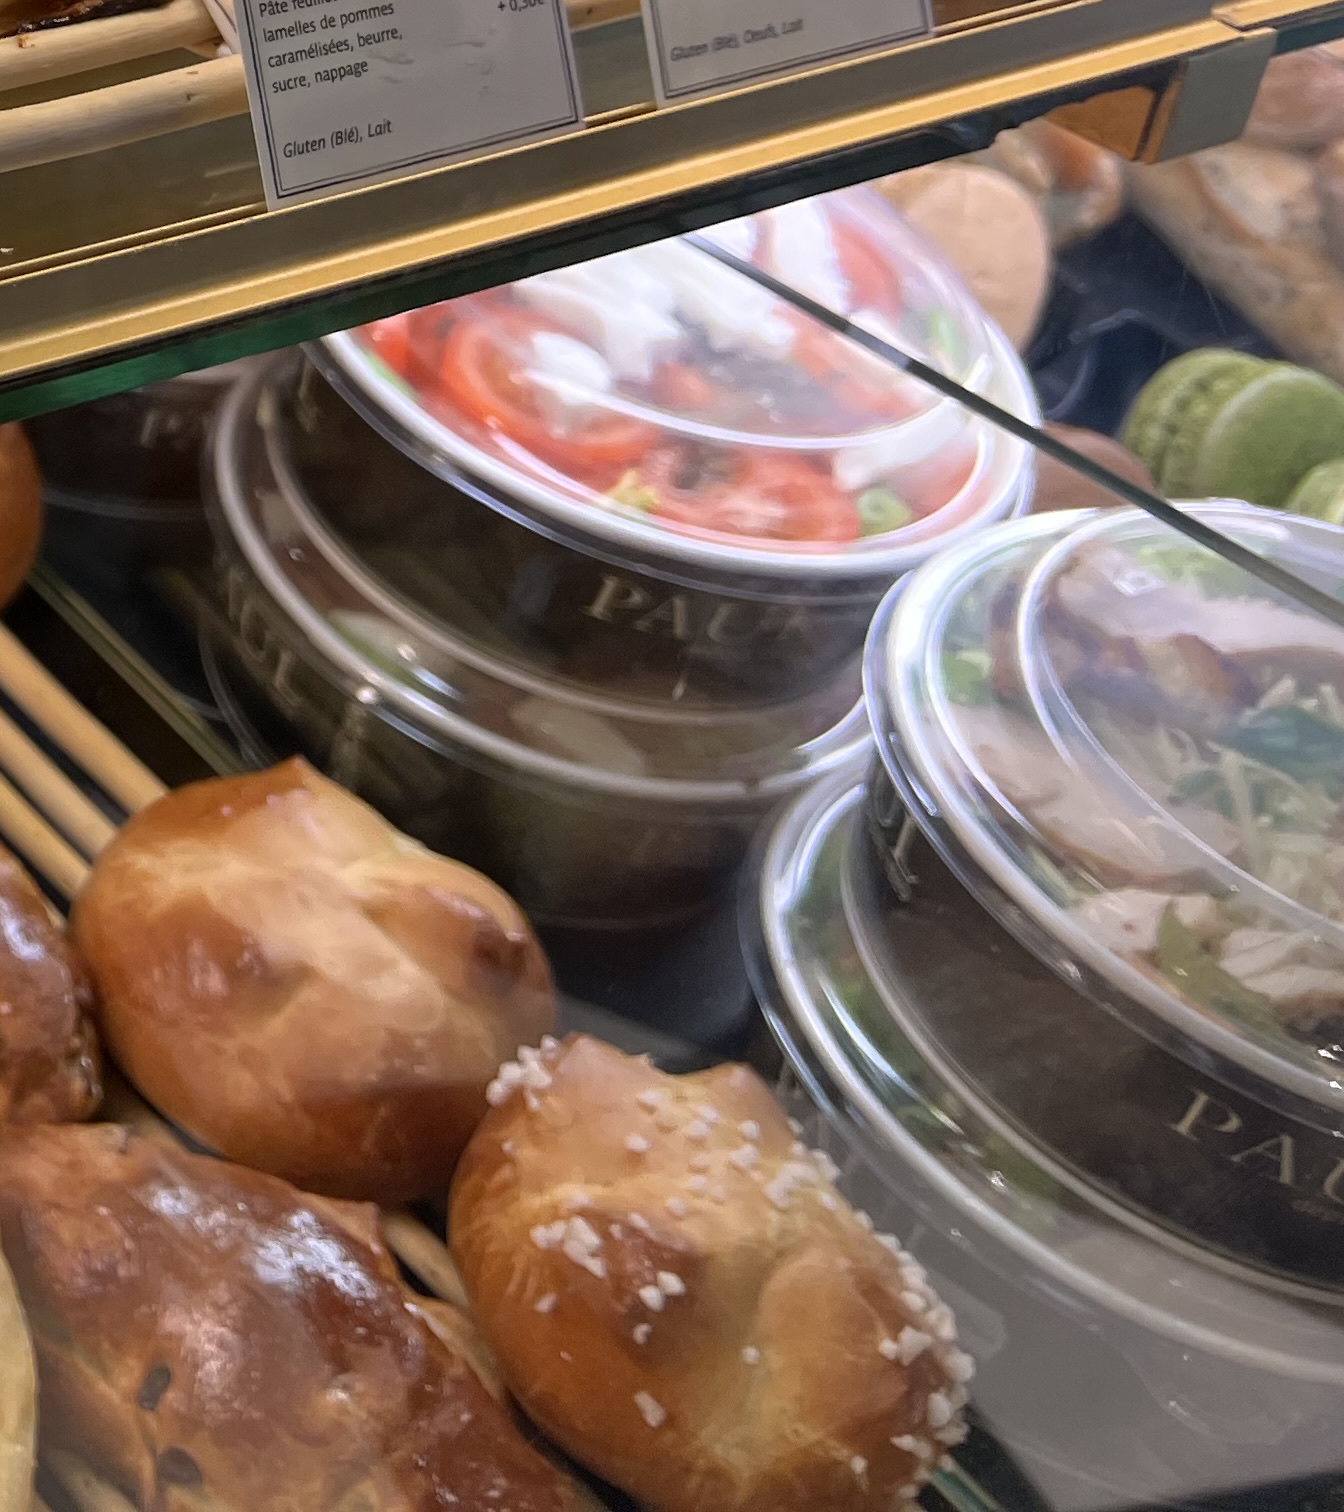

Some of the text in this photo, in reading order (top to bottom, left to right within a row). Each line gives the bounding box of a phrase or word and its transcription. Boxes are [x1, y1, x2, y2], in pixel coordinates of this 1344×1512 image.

[258, 0, 289, 18] Pâte
[262, 2, 395, 43] lamelles de pommes
[267, 27, 403, 69] caramélisées, beurre,
[271, 60, 369, 94] sucre, nappage
[283, 119, 392, 158] Gluten (Blé), Lait
